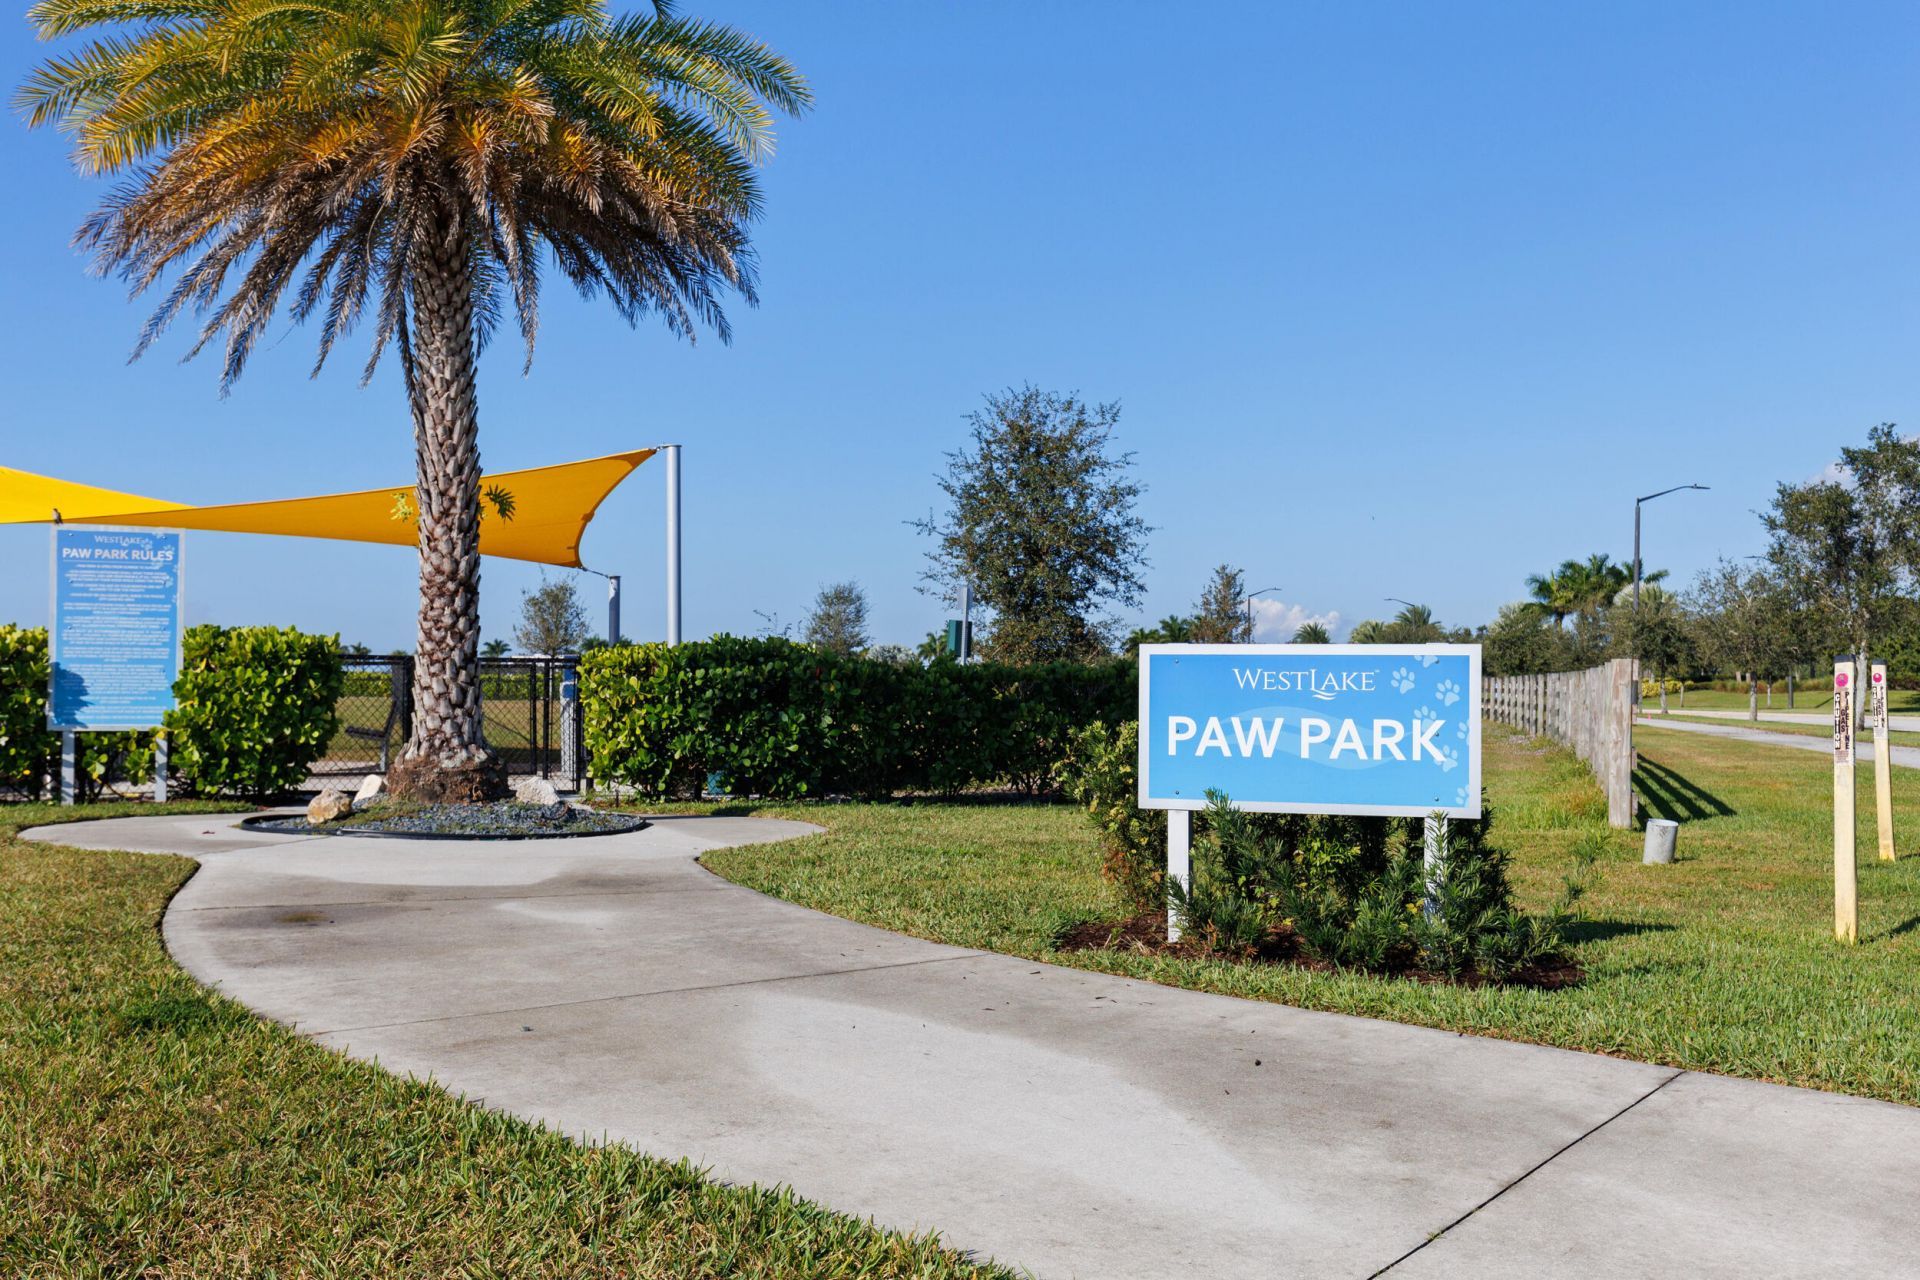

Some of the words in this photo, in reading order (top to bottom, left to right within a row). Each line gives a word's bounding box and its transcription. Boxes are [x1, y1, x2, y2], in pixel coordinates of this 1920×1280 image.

[62, 548, 92, 559] PAW
[94, 549, 129, 560] PARK
[131, 550, 174, 561] RULES
[1167, 715, 1285, 759] PAW
[1300, 718, 1447, 762] PARK
